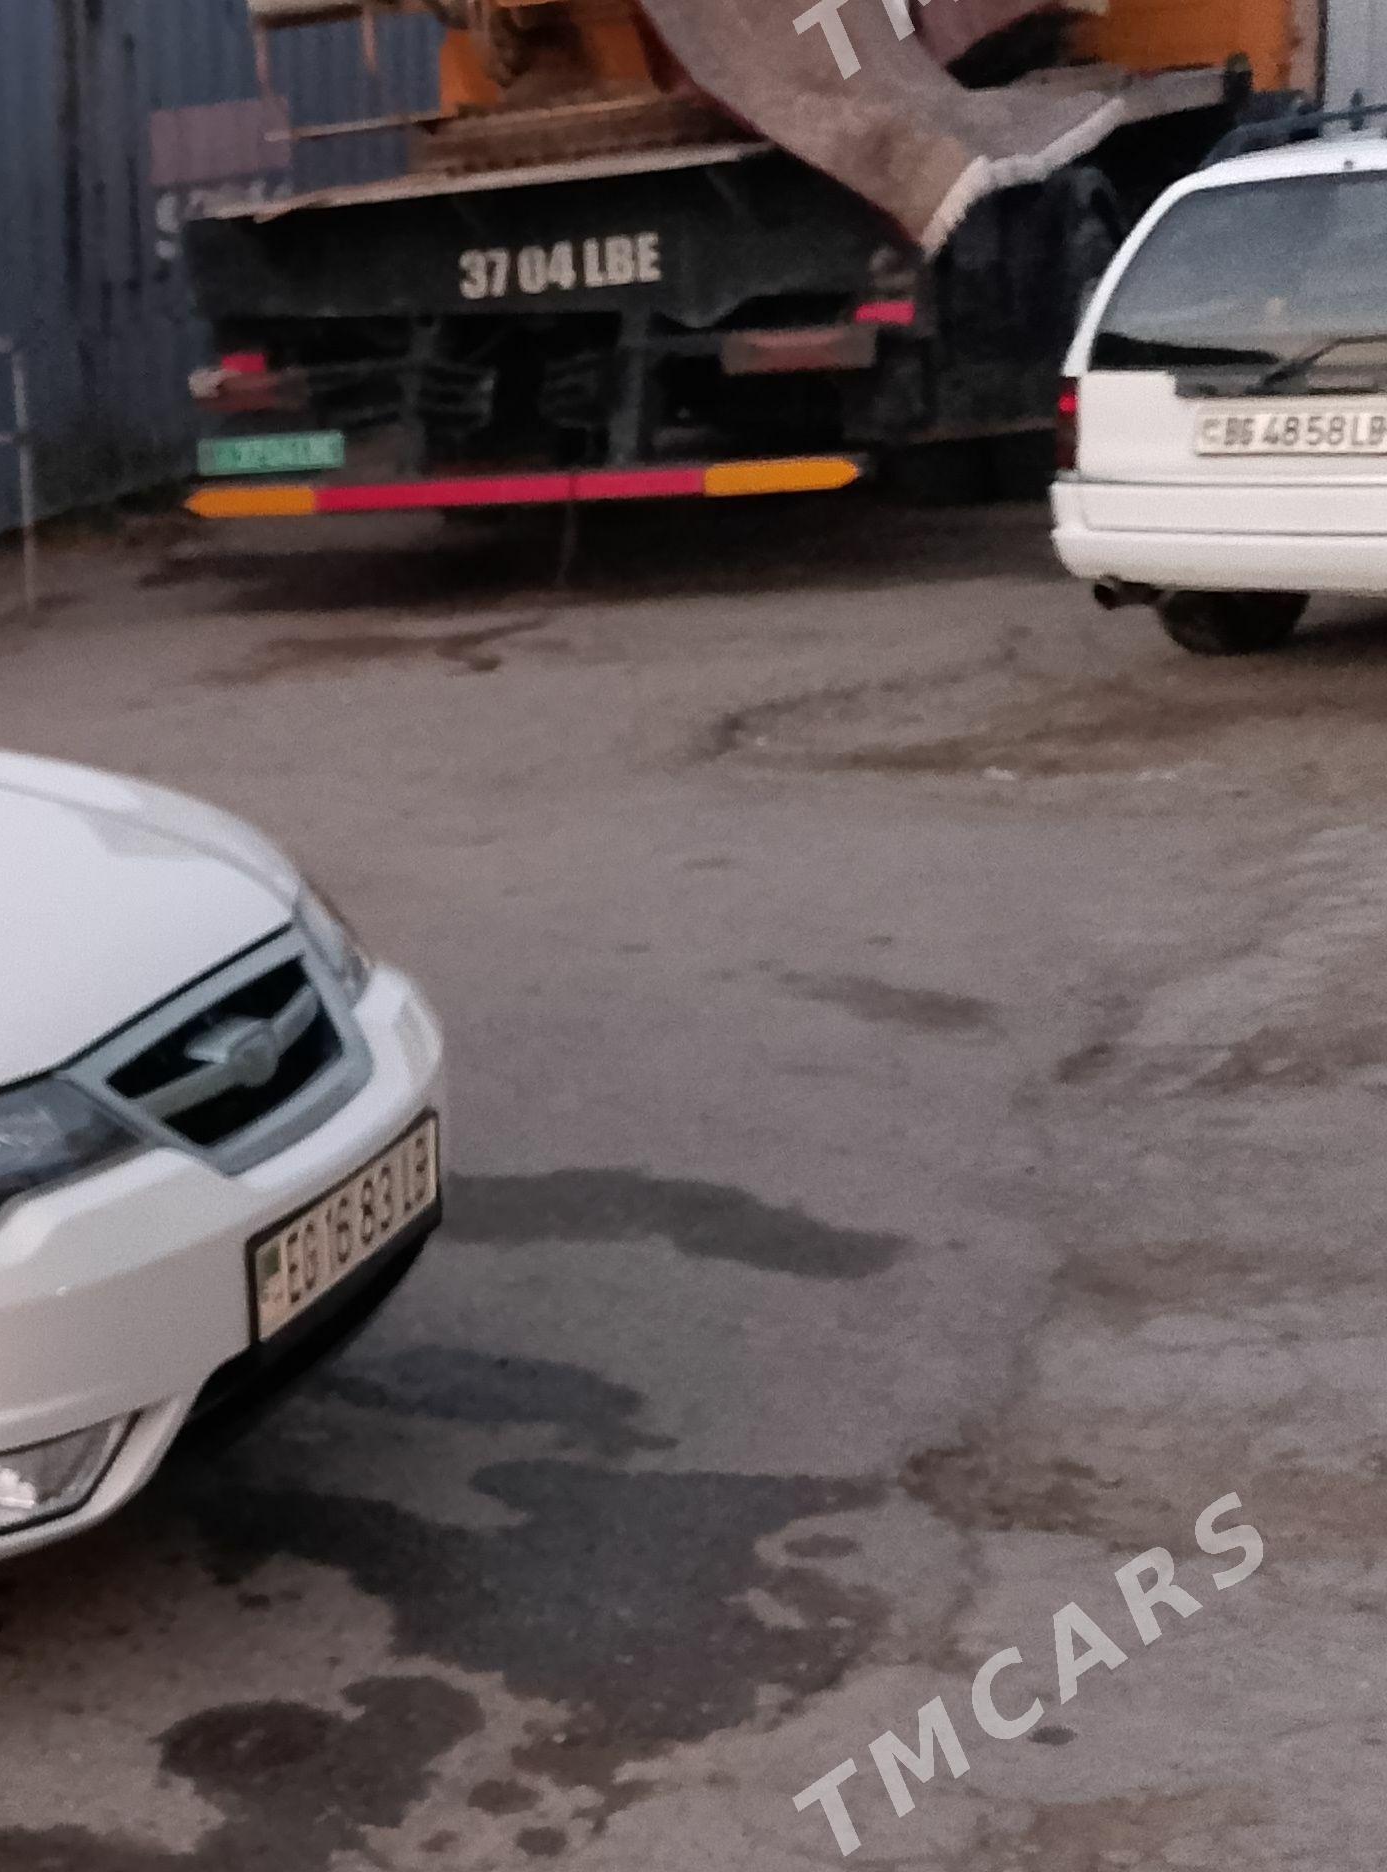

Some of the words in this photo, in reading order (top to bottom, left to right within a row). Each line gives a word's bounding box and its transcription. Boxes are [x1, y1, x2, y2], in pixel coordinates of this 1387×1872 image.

[458, 249, 509, 300] 37
[517, 244, 577, 295] 04
[582, 230, 662, 288] LBE
